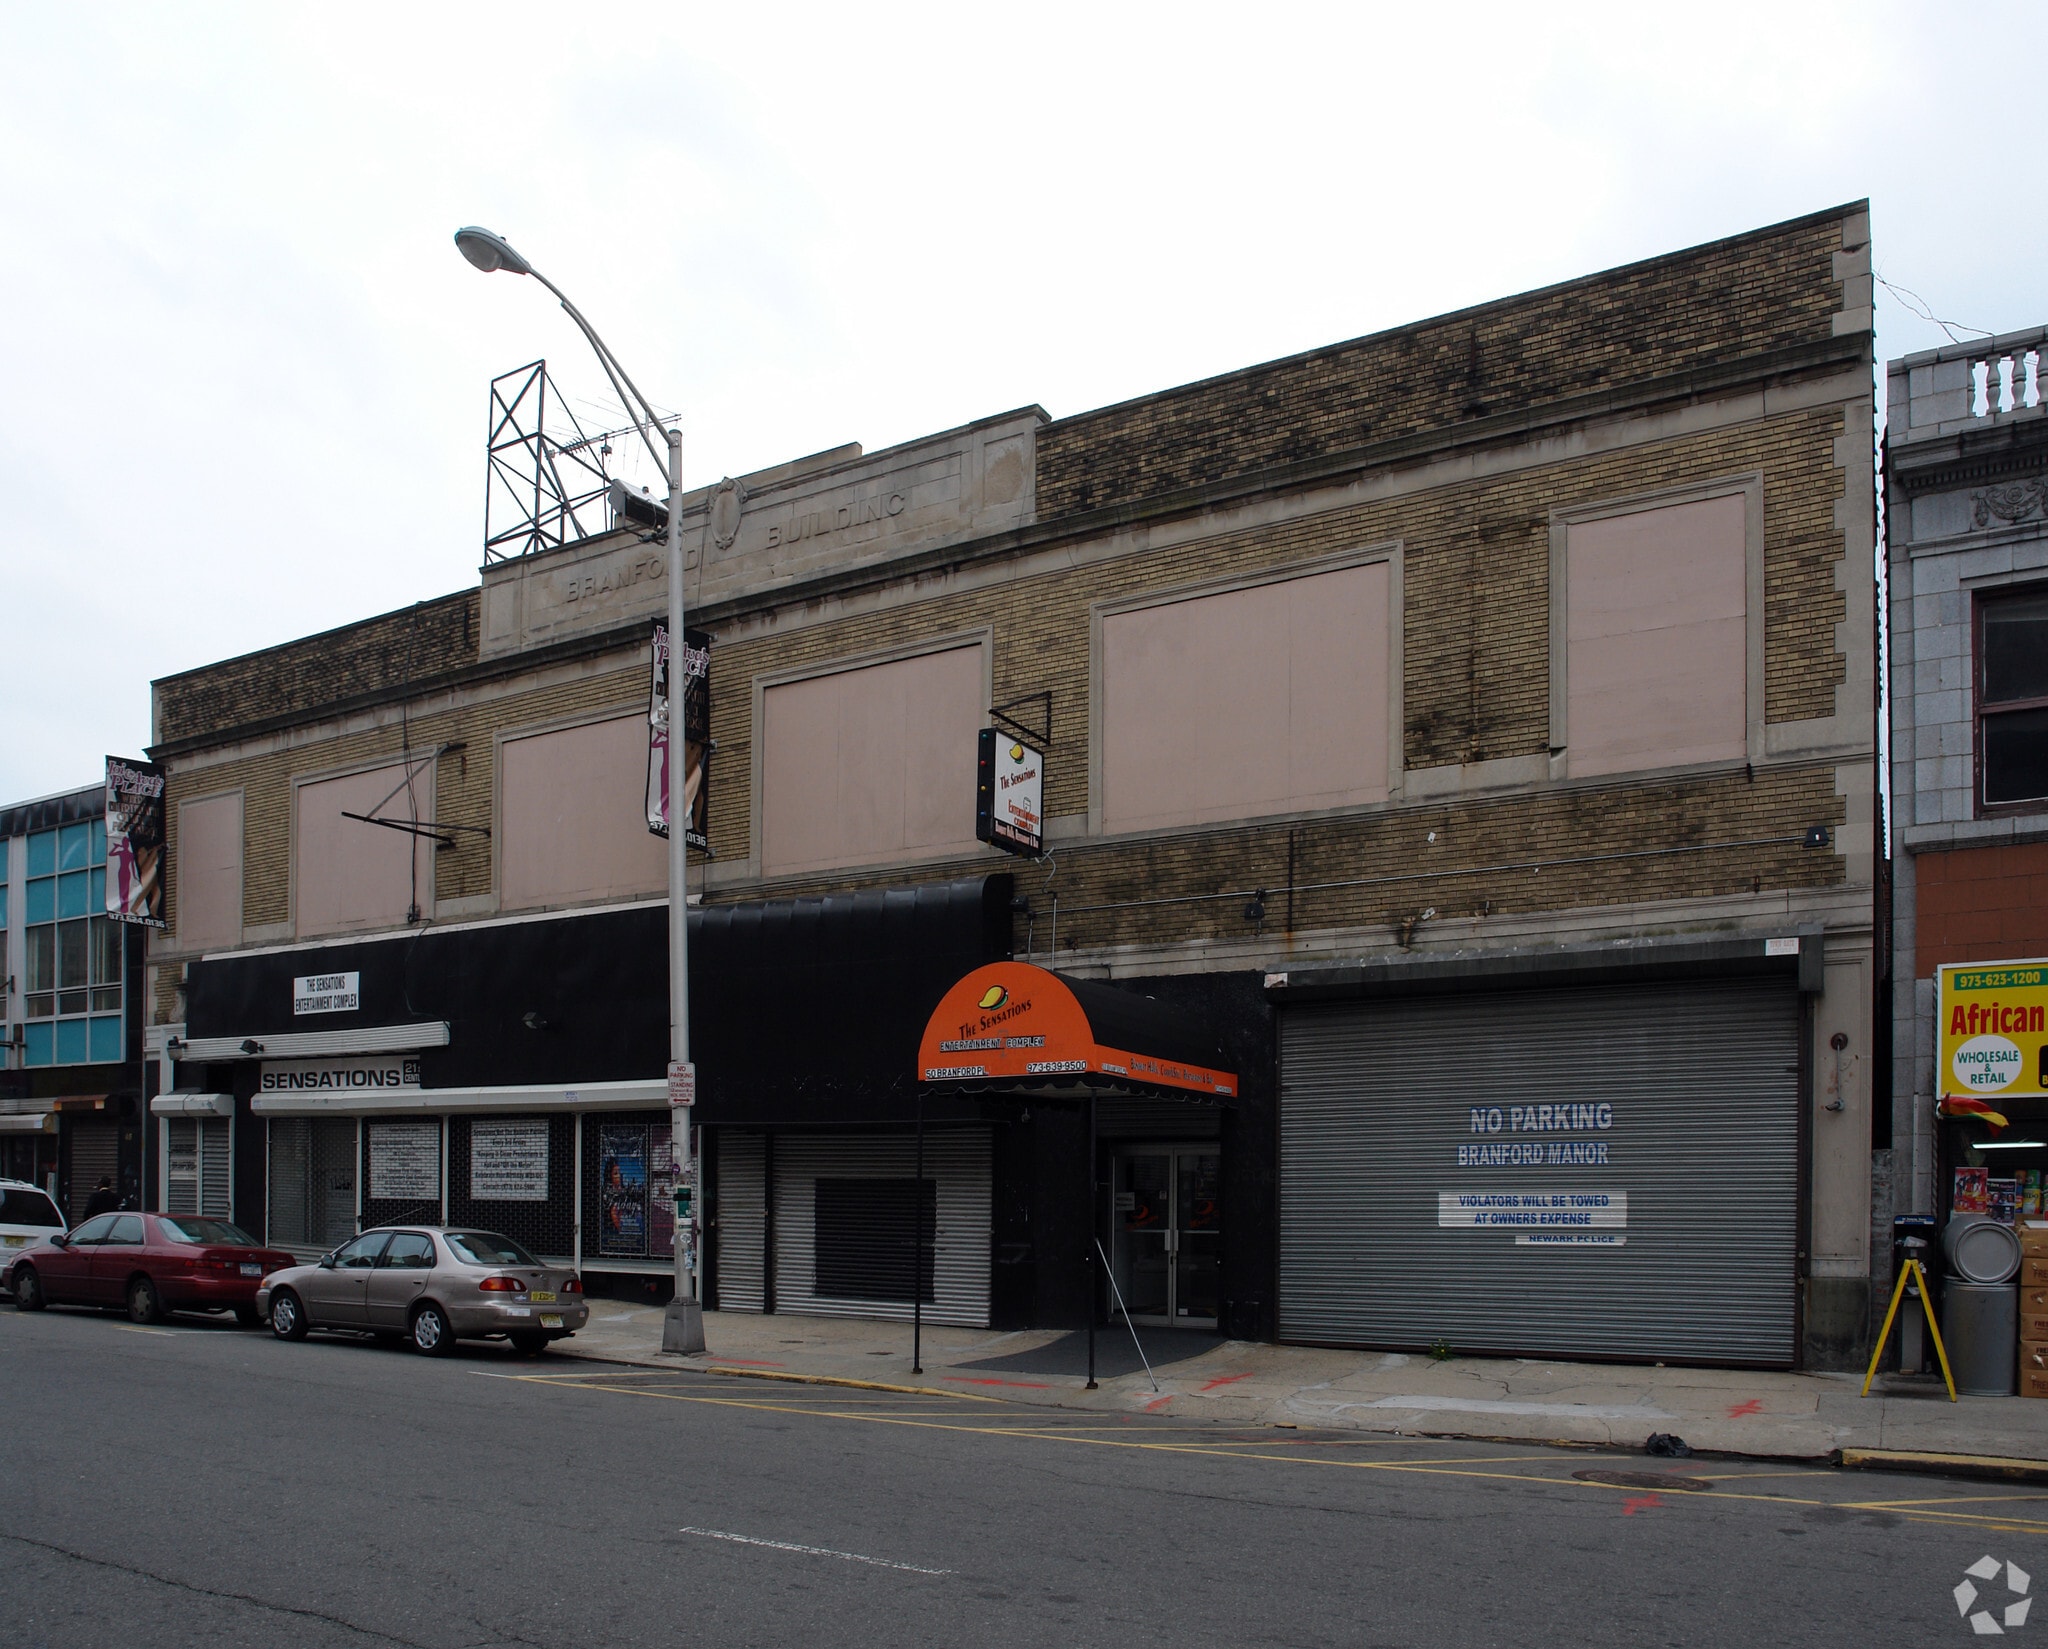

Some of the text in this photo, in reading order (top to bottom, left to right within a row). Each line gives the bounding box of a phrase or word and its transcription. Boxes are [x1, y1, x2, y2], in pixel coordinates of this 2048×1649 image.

[567, 494, 905, 603] BRANFOD BUILDING
[651, 624, 669, 646] Jo
[656, 644, 706, 678] PCE
[110, 774, 162, 798] PLACE
[306, 975, 345, 992] THE SENSATIONS
[1960, 971, 2041, 988] 973-623-1200
[295, 993, 357, 1012] ENTERTAINMENT COMPLEX
[1950, 1002, 2044, 1036] African
[939, 1036, 1045, 1051] ENTERTAINMENT COMPLEX
[1957, 1050, 2018, 1064] WHOLESALE
[937, 1067, 977, 1077] BRANFORD
[1026, 1060, 1087, 1073] 973-639-9500
[1984, 1063, 1991, 1073] &
[263, 1070, 400, 1089] SENSATIONS
[1970, 1072, 2007, 1085] RETAIL
[1470, 1103, 1613, 1134] NO PARKING
[1457, 1142, 1609, 1166] BRANFORD MANOR
[1459, 1194, 1609, 1207] VIOLATORS WILL BE TOWED
[1474, 1213, 1591, 1225] AT OWNERS EXPENSE
[1529, 1235, 1615, 1243] NEWARK POLICE
